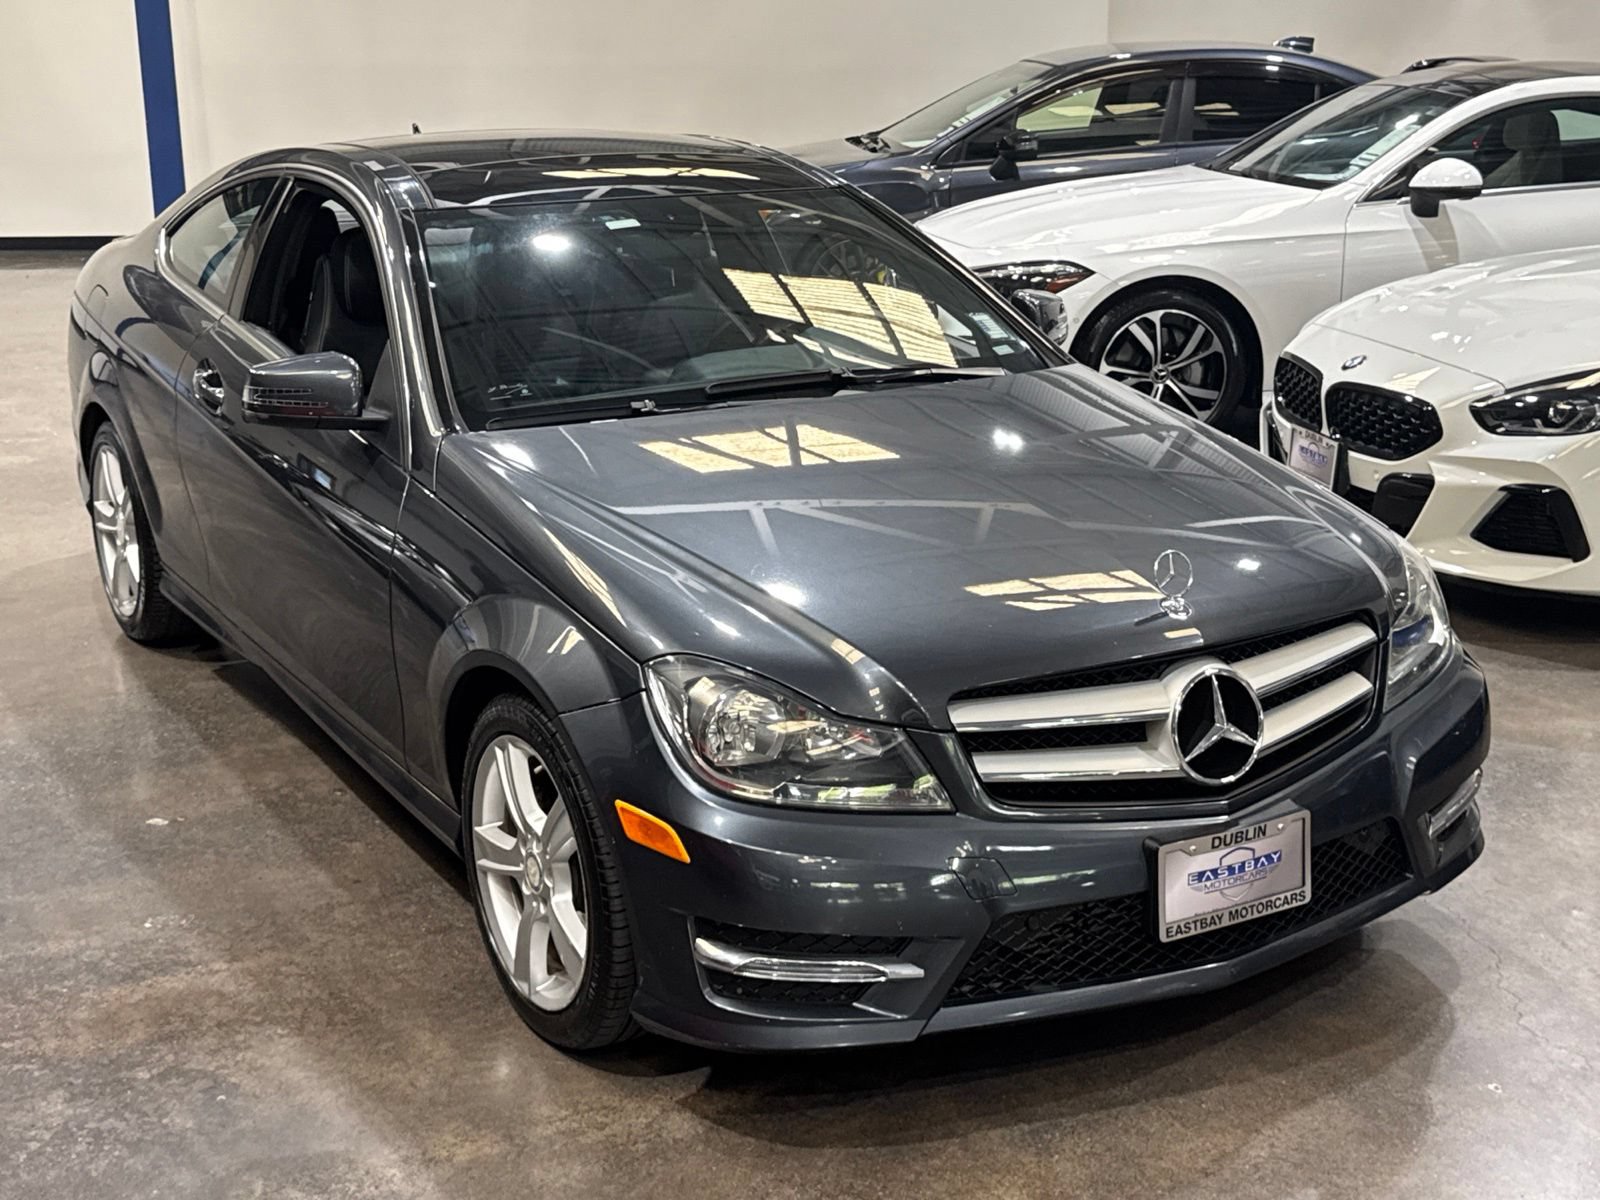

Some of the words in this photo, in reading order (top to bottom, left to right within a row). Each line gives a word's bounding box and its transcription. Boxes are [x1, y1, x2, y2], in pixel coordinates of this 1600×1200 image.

[1211, 824, 1267, 849] DUBLIN
[1189, 850, 1281, 885] EASTBAY
[1204, 868, 1268, 891] MOTORCARS
[1165, 913, 1224, 939] EASTBAY
[1228, 890, 1307, 923] MOTORCARS
